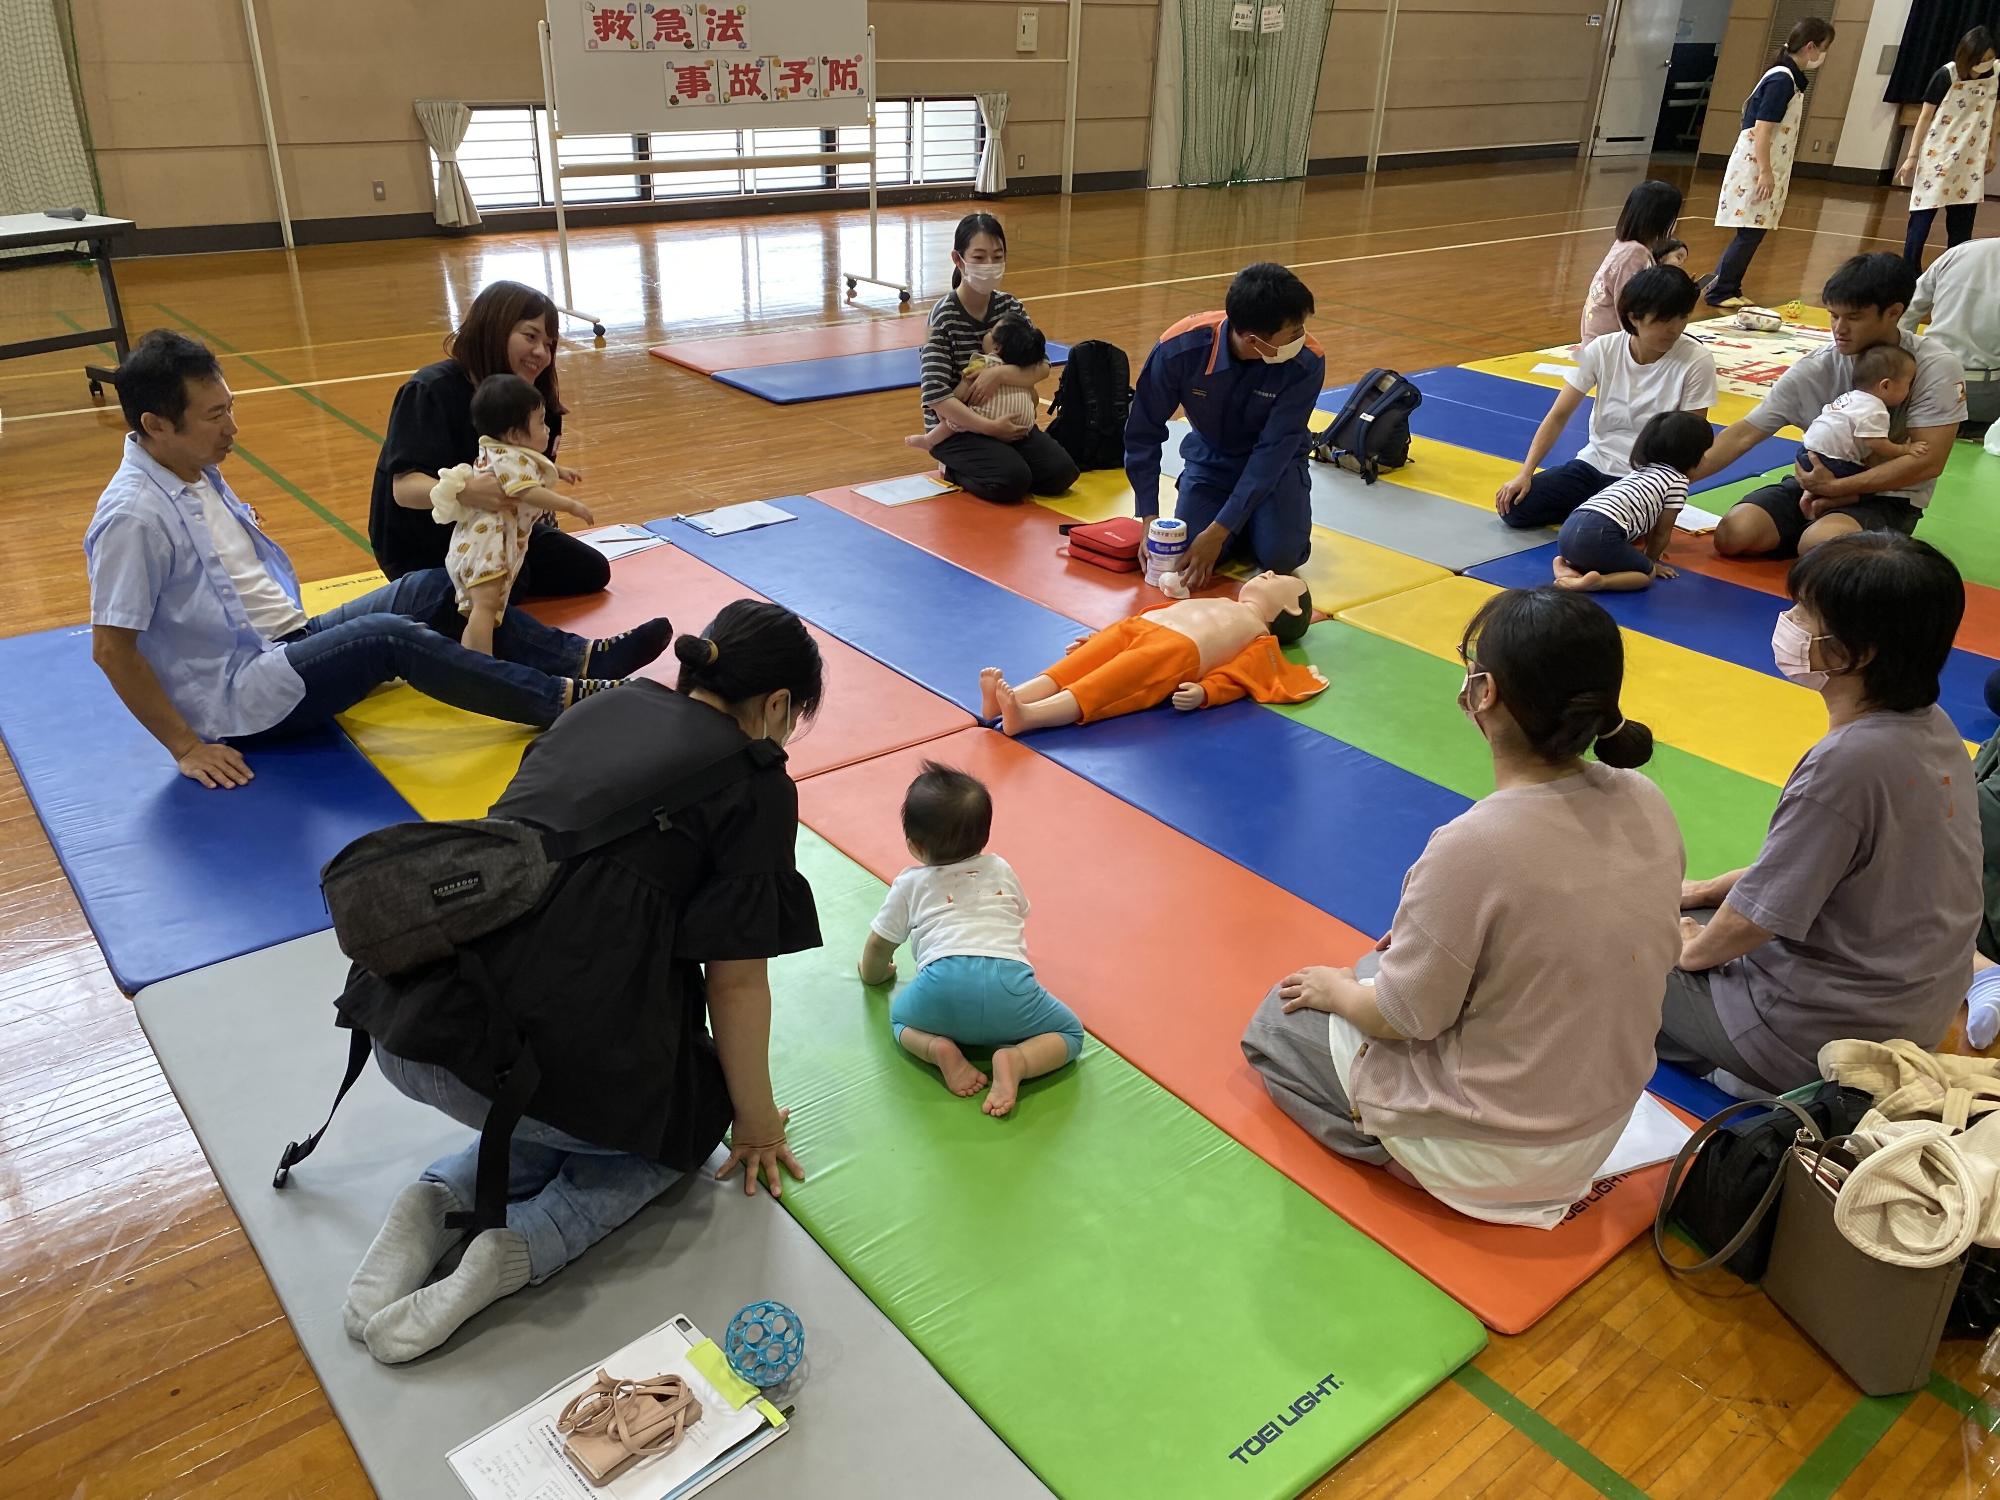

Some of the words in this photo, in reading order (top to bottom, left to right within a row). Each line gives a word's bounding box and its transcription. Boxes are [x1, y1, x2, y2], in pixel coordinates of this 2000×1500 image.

[592, 8, 745, 42] 救急法
[673, 58, 859, 99] 事故予防
[1228, 1420, 1284, 1465] TOEI
[1276, 1372, 1341, 1427] LIGHT
